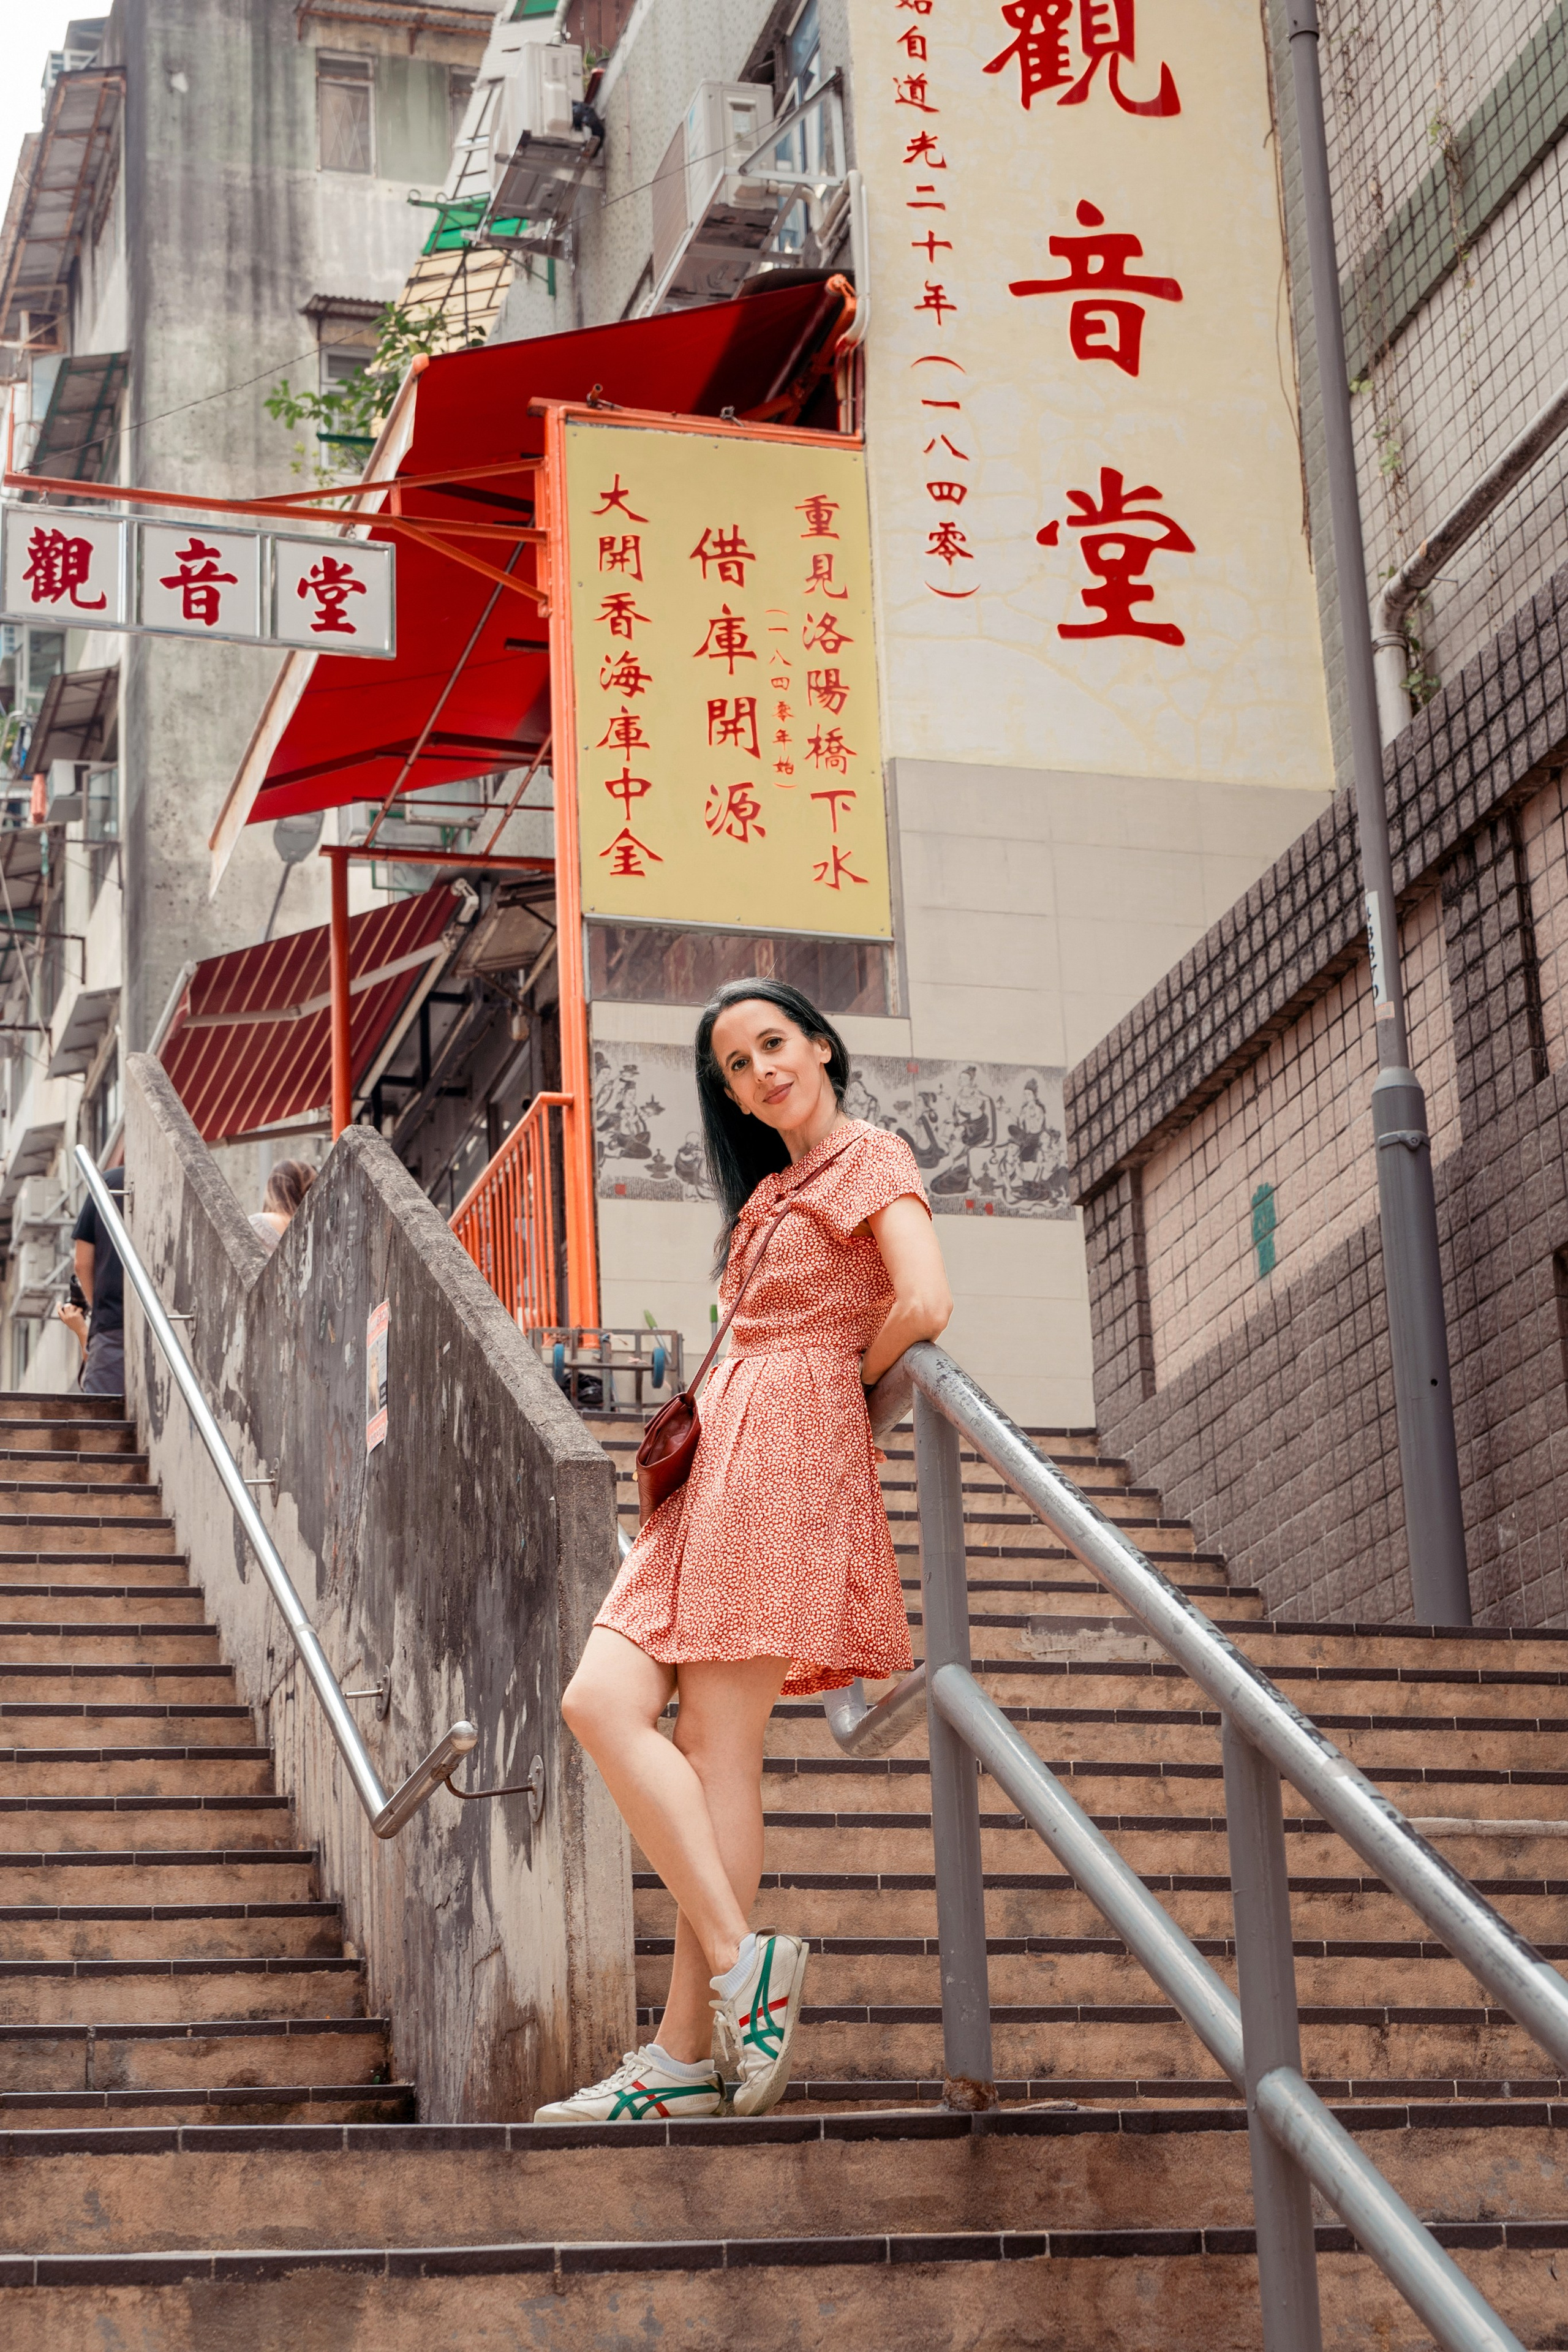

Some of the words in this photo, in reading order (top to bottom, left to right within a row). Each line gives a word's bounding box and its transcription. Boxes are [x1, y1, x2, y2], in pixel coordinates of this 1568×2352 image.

[23, 527, 366, 634] 觀音堂
[592, 473, 663, 877] 大開香海庫中金
[690, 524, 766, 844] 借庫開源
[794, 494, 869, 891] 重見洛陽橋下水
